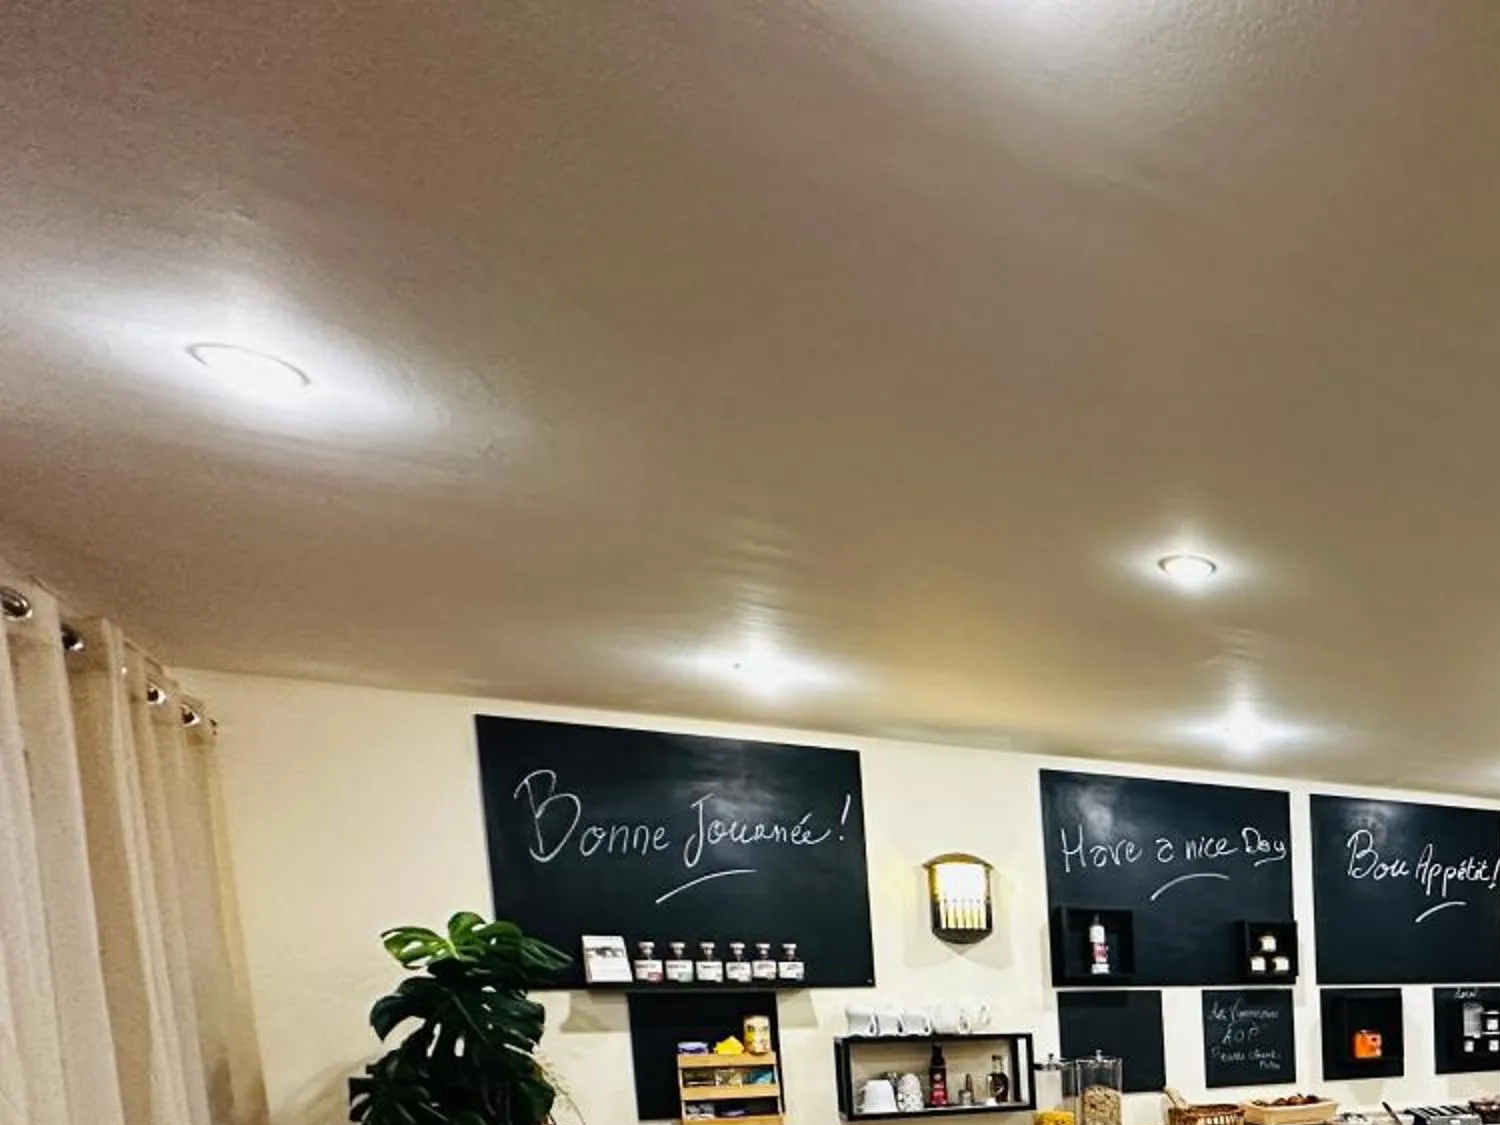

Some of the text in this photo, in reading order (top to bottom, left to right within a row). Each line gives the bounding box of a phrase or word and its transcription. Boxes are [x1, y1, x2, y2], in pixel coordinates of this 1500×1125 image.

[513, 768, 671, 864] Bonne
[1060, 824, 1287, 873] Have a nice Day
